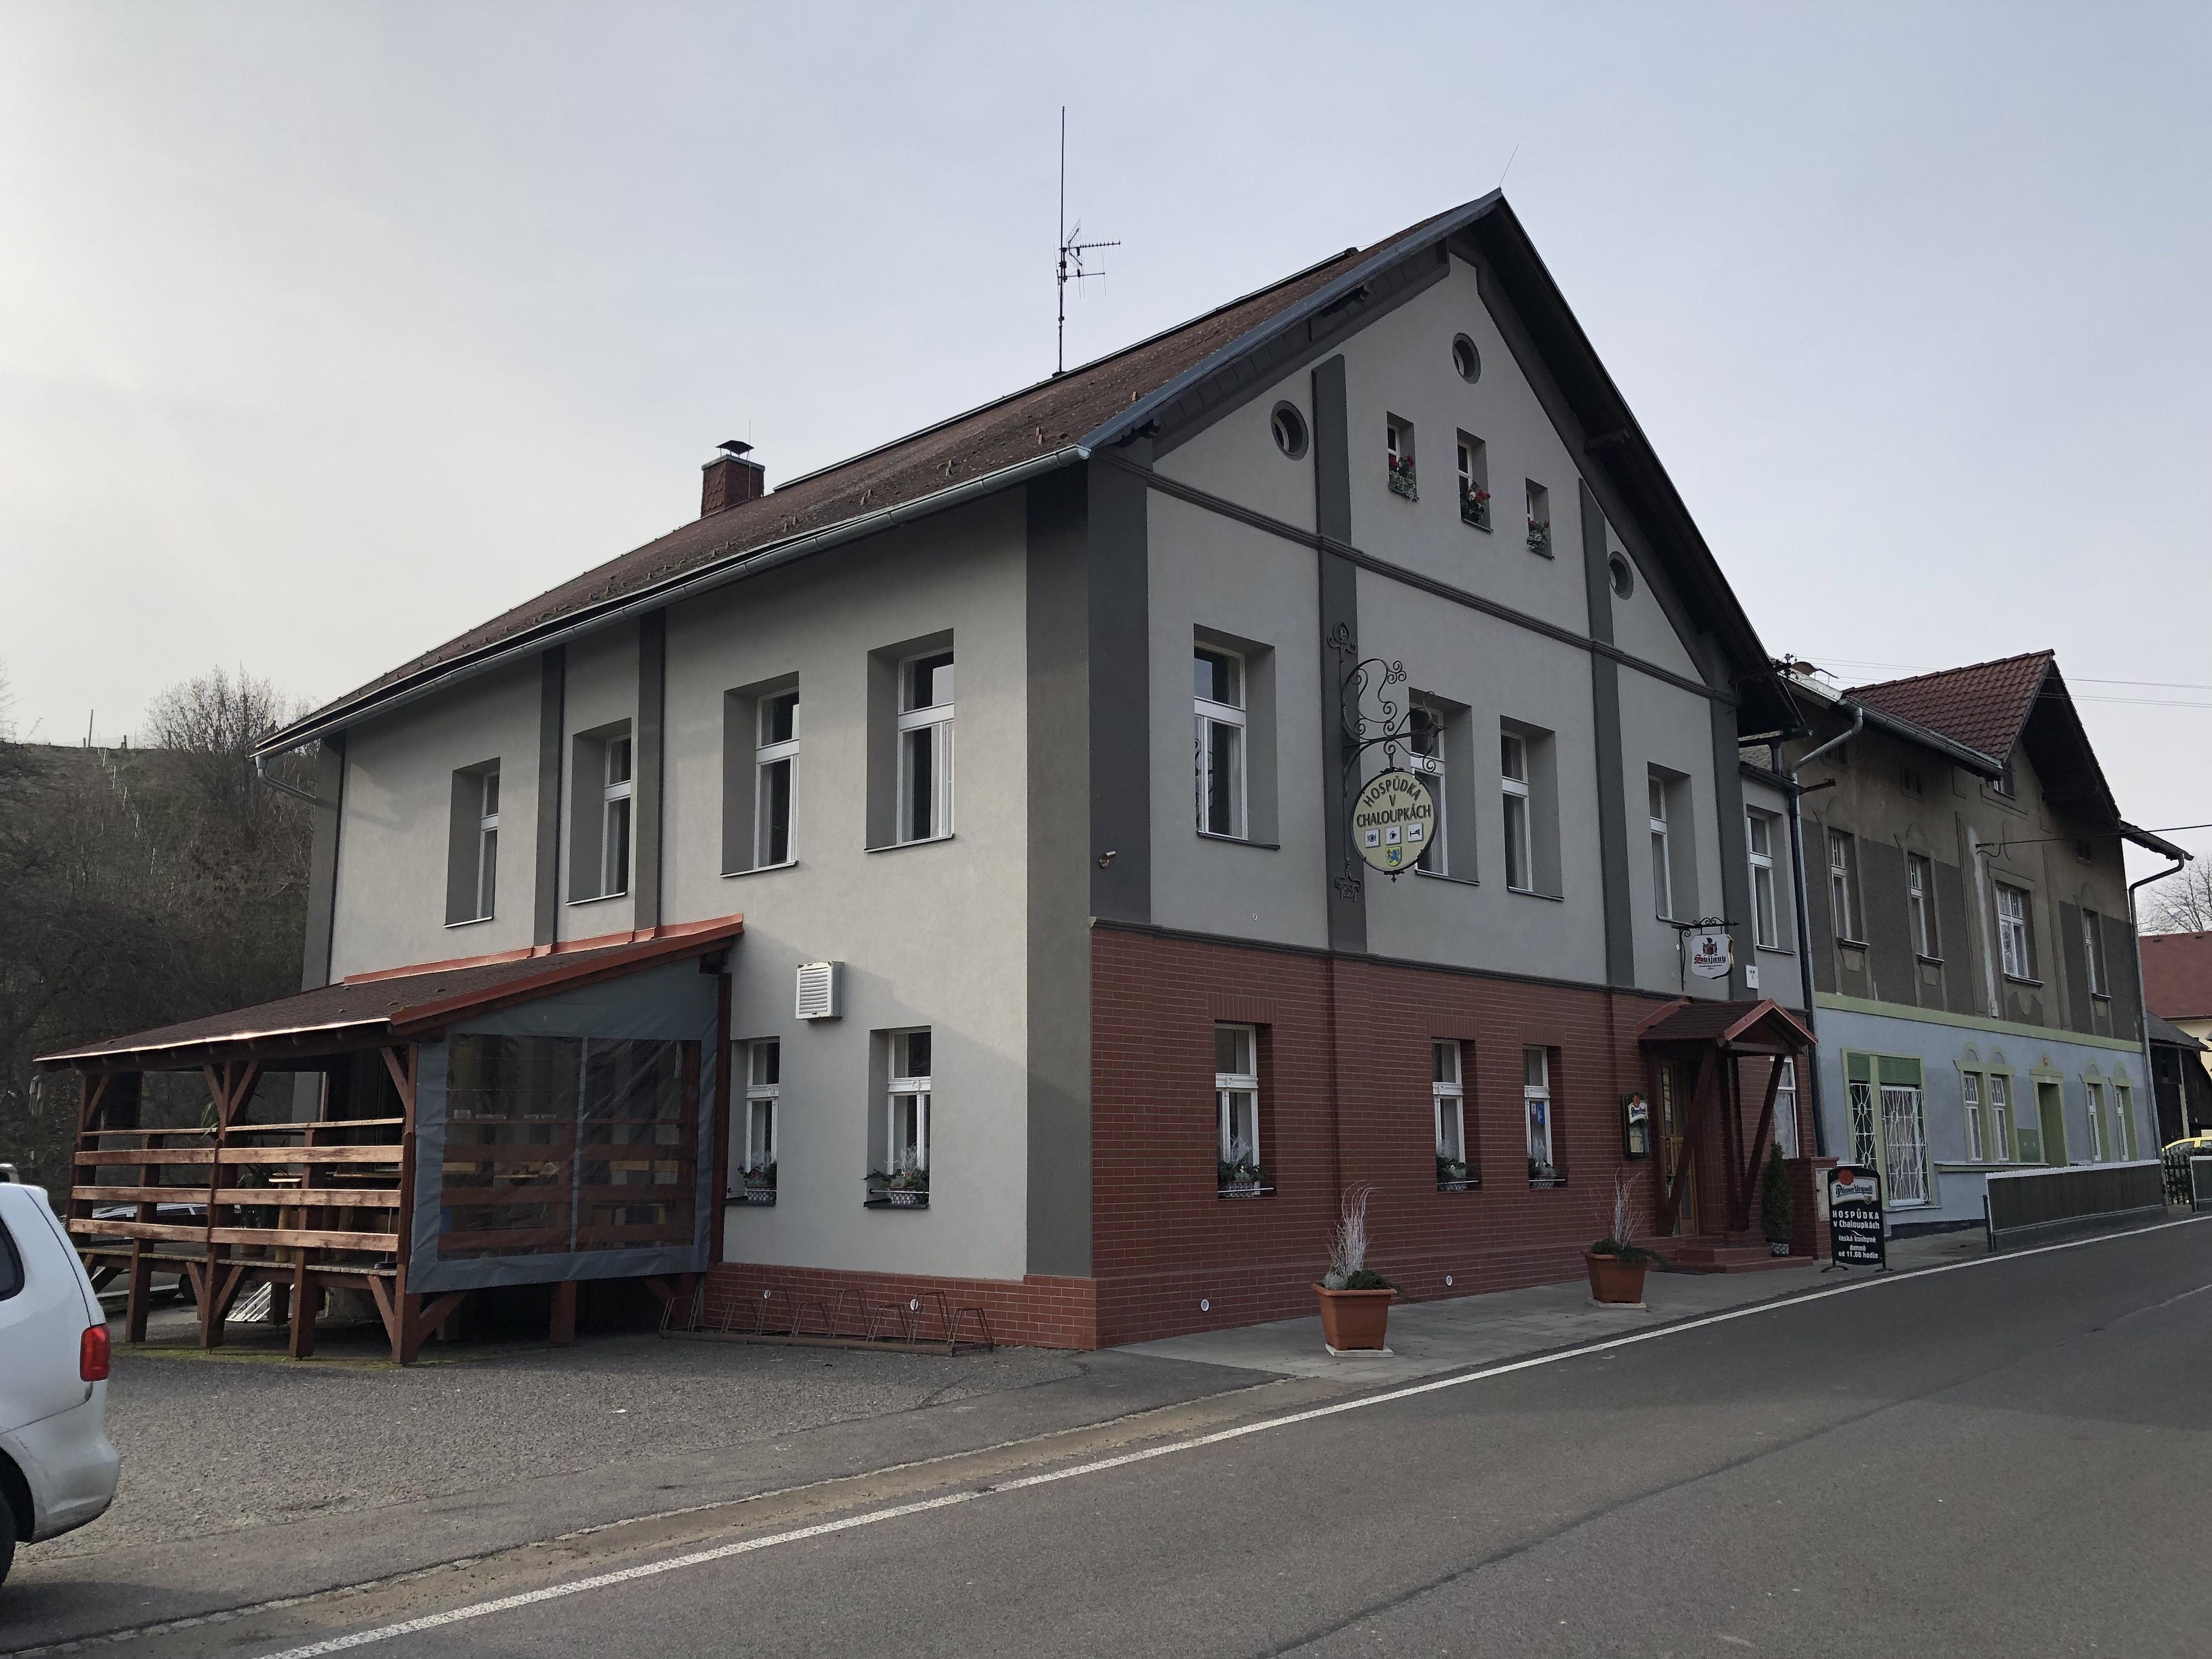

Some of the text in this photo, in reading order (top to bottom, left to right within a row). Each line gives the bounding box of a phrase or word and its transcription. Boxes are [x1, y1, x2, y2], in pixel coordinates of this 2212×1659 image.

[1363, 775, 1421, 807] HOSPŮDKA
[1389, 794, 1396, 807] V
[1357, 803, 1431, 827] CHALOUPKÁCH
[1694, 954, 1726, 964] Svijany
[1833, 1208, 1880, 1219] HOSPŮDKA
[1839, 1220, 1880, 1229] Chaloupkách
